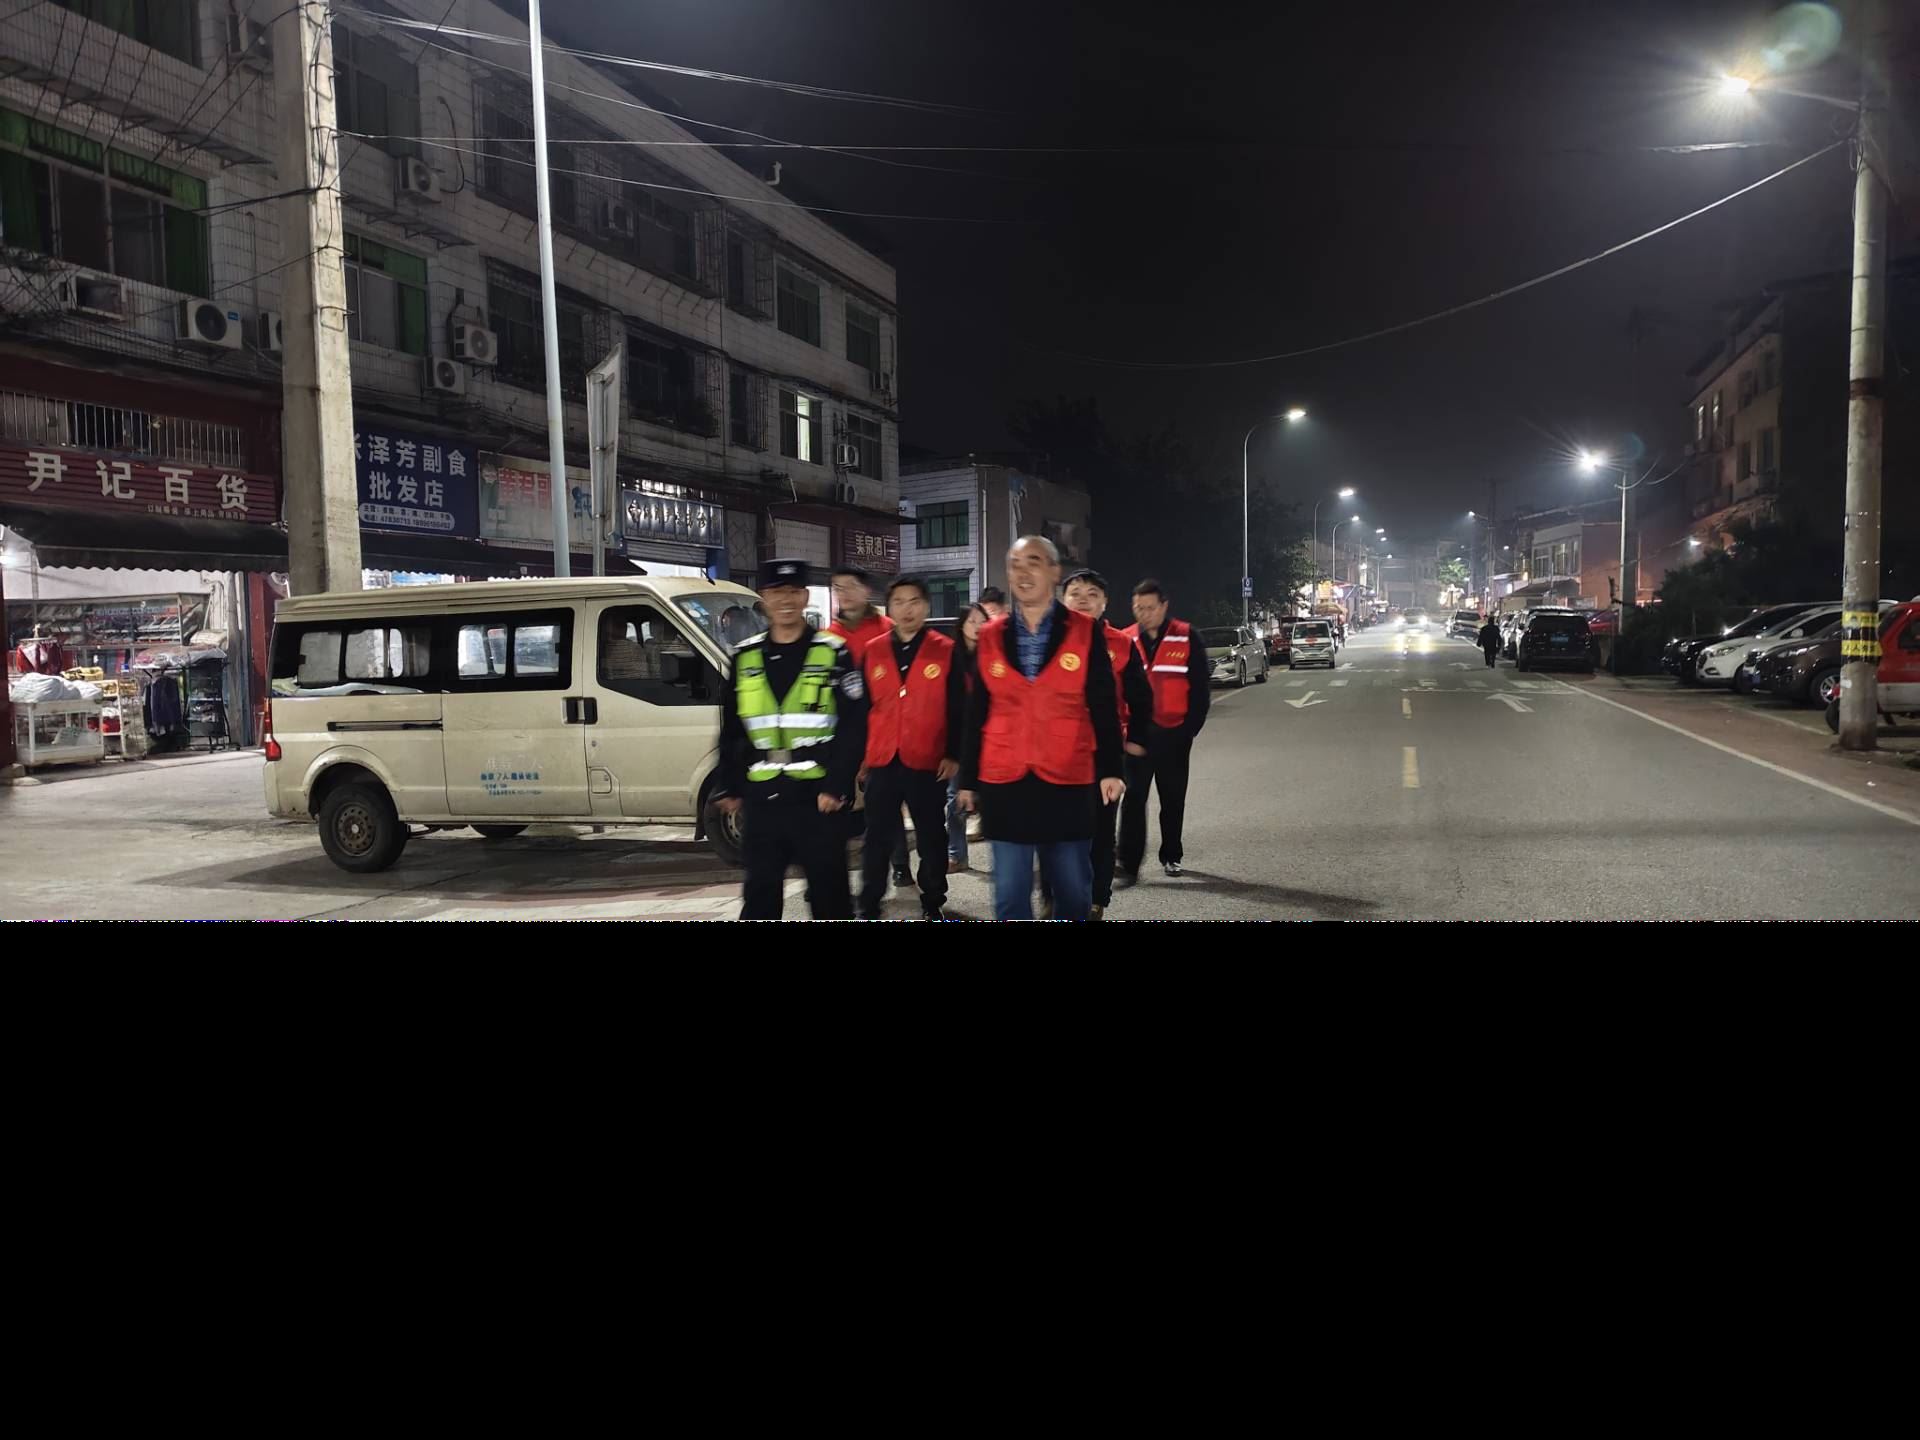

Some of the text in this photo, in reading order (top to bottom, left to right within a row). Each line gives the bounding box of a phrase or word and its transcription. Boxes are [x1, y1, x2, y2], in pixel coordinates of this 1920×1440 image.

[24, 451, 249, 512] 尹记百货
[368, 471, 444, 508] 批发店
